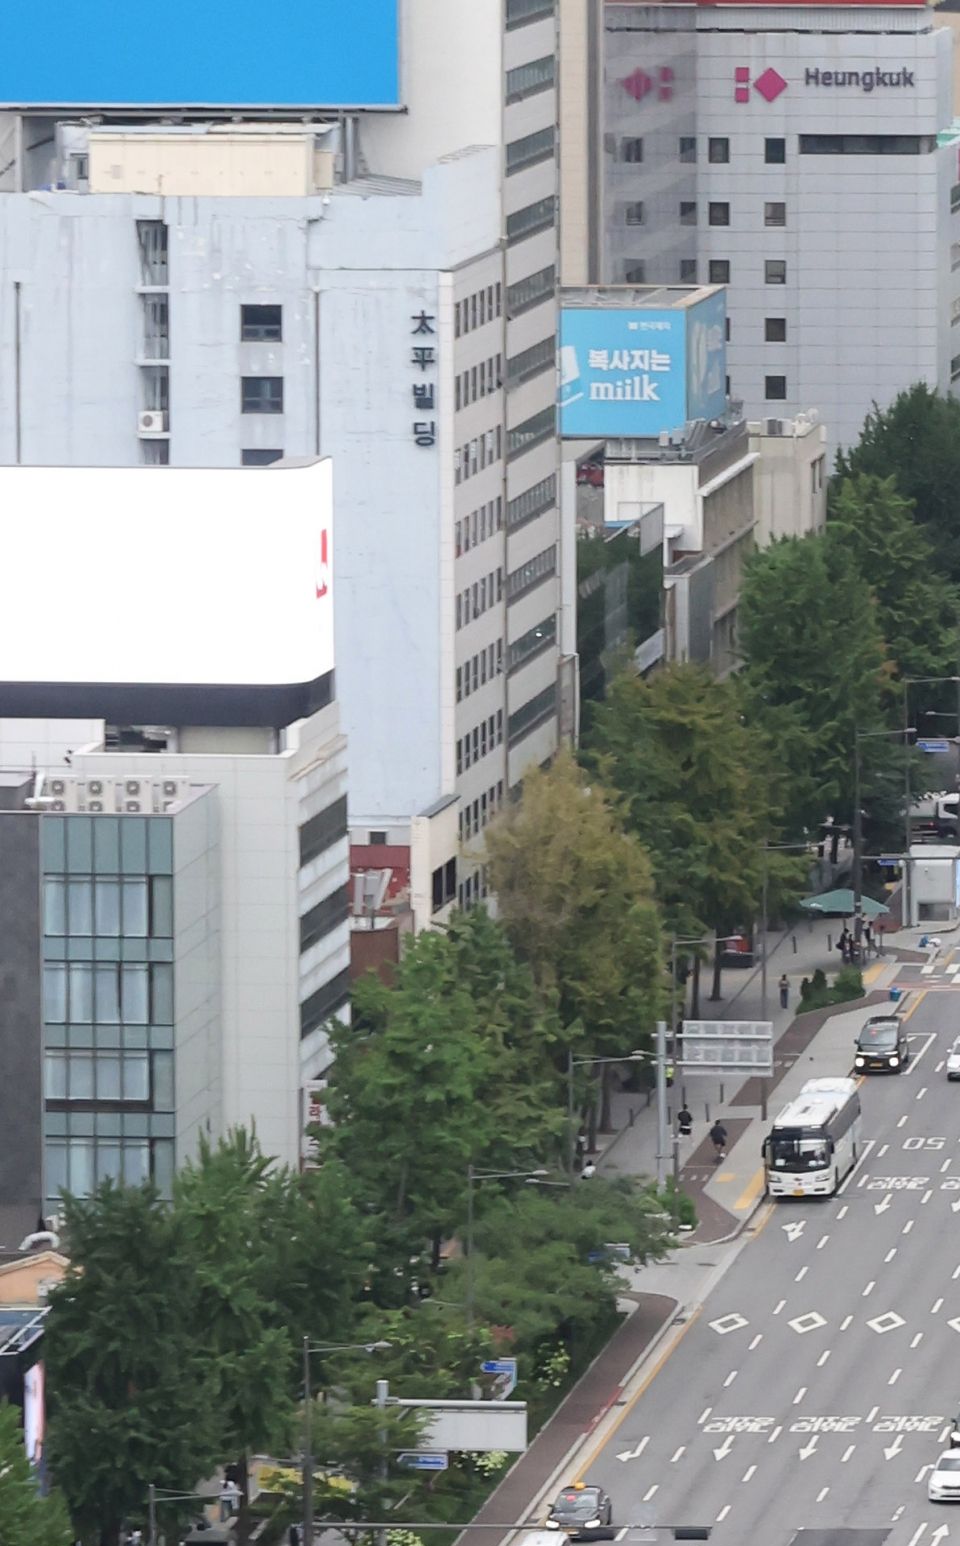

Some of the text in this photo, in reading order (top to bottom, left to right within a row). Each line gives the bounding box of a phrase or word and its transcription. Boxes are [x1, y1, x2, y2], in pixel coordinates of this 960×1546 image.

[804, 67, 915, 92] Heungkuk
[588, 349, 671, 372] 복사지는
[410, 310, 436, 447] 太平빌딩
[589, 374, 660, 401] miilk
[902, 1137, 947, 1150] 50
[866, 1176, 930, 1191] 광화문
[702, 1416, 776, 1433] 광화문
[789, 1416, 862, 1433] 광화문
[872, 1415, 944, 1432] 광화문
